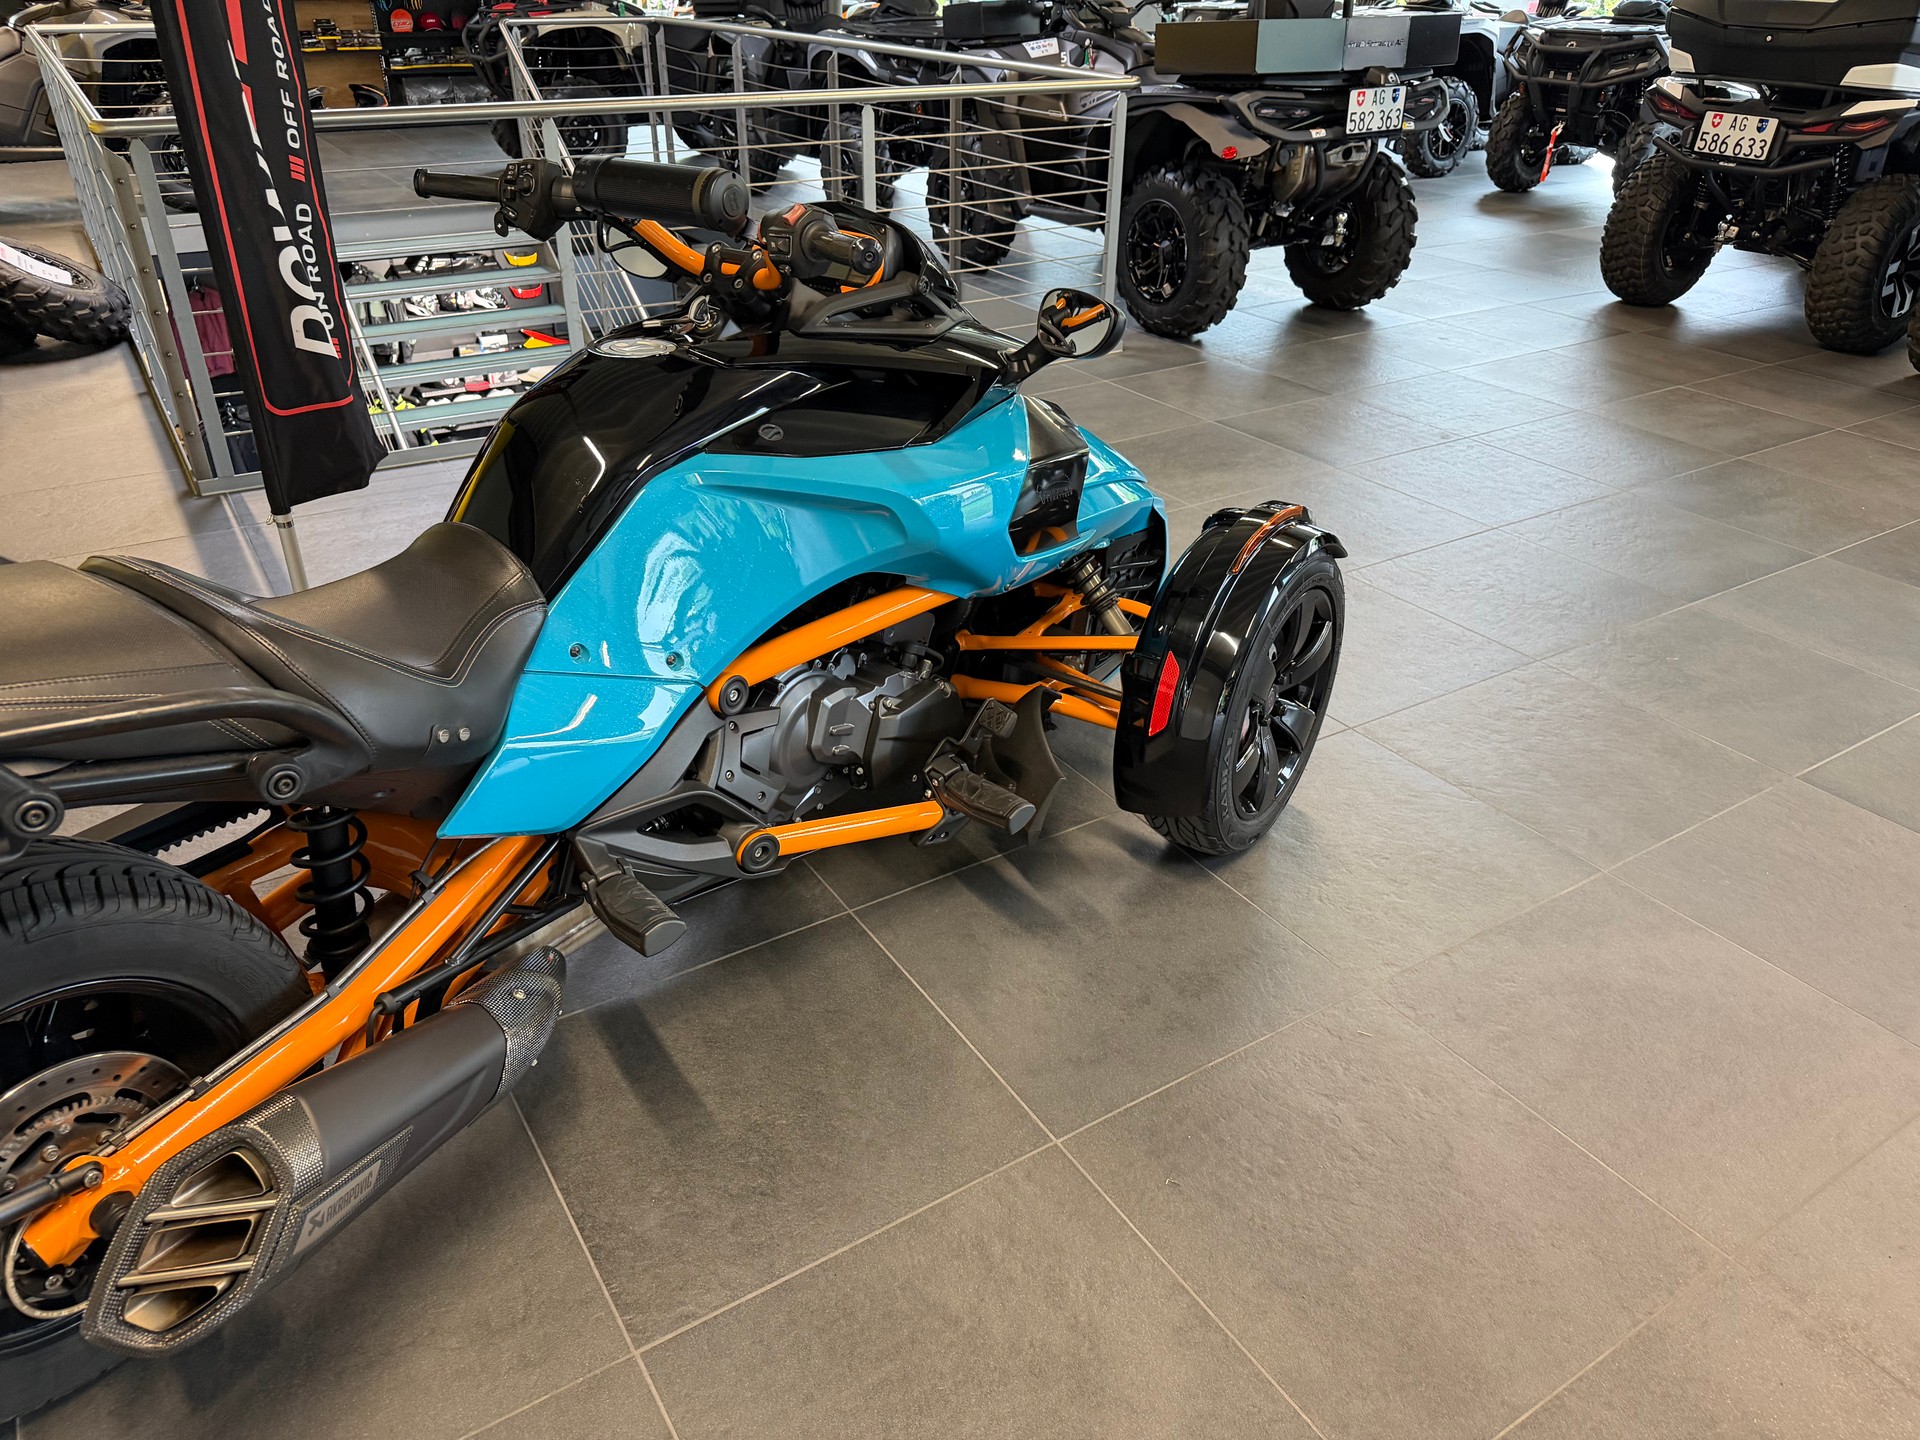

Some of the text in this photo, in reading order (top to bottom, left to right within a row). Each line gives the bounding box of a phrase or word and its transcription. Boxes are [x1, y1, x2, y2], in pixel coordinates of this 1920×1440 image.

[262, 0, 290, 81] ROAD
[1060, 51, 1067, 63] 5
[1371, 89, 1386, 107] AG
[280, 89, 301, 150] OFF
[1348, 107, 1402, 133] 582 363
[1728, 115, 1749, 132] AG
[1697, 131, 1768, 159] 586 633
[295, 203, 322, 283] ROAD
